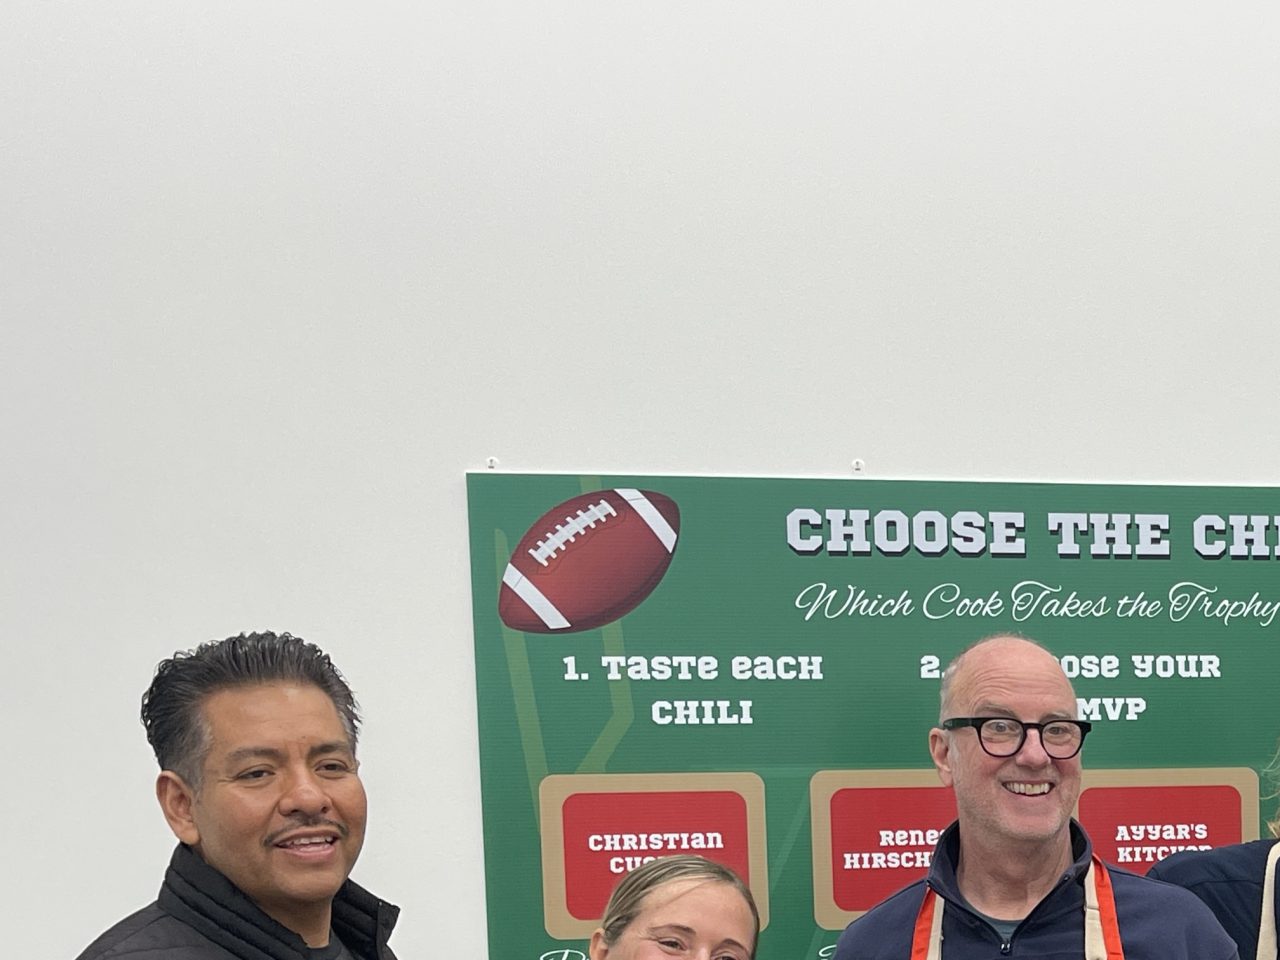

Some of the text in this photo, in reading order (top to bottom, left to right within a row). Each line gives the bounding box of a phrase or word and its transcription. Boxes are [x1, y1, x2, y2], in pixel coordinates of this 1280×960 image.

[786, 508, 1026, 557] CHOOSE
[1048, 512, 1170, 559] THE
[795, 583, 915, 621] Which
[922, 583, 1004, 619] Cook
[1011, 581, 1111, 622] Takes
[1116, 591, 1163, 618] the
[563, 656, 589, 680] 1.
[1131, 655, 1221, 678] YOUR
[652, 700, 753, 724] CHILI
[1076, 697, 1146, 720] MVP
[879, 829, 945, 846] Rene
[843, 851, 934, 869] HIRSCH
